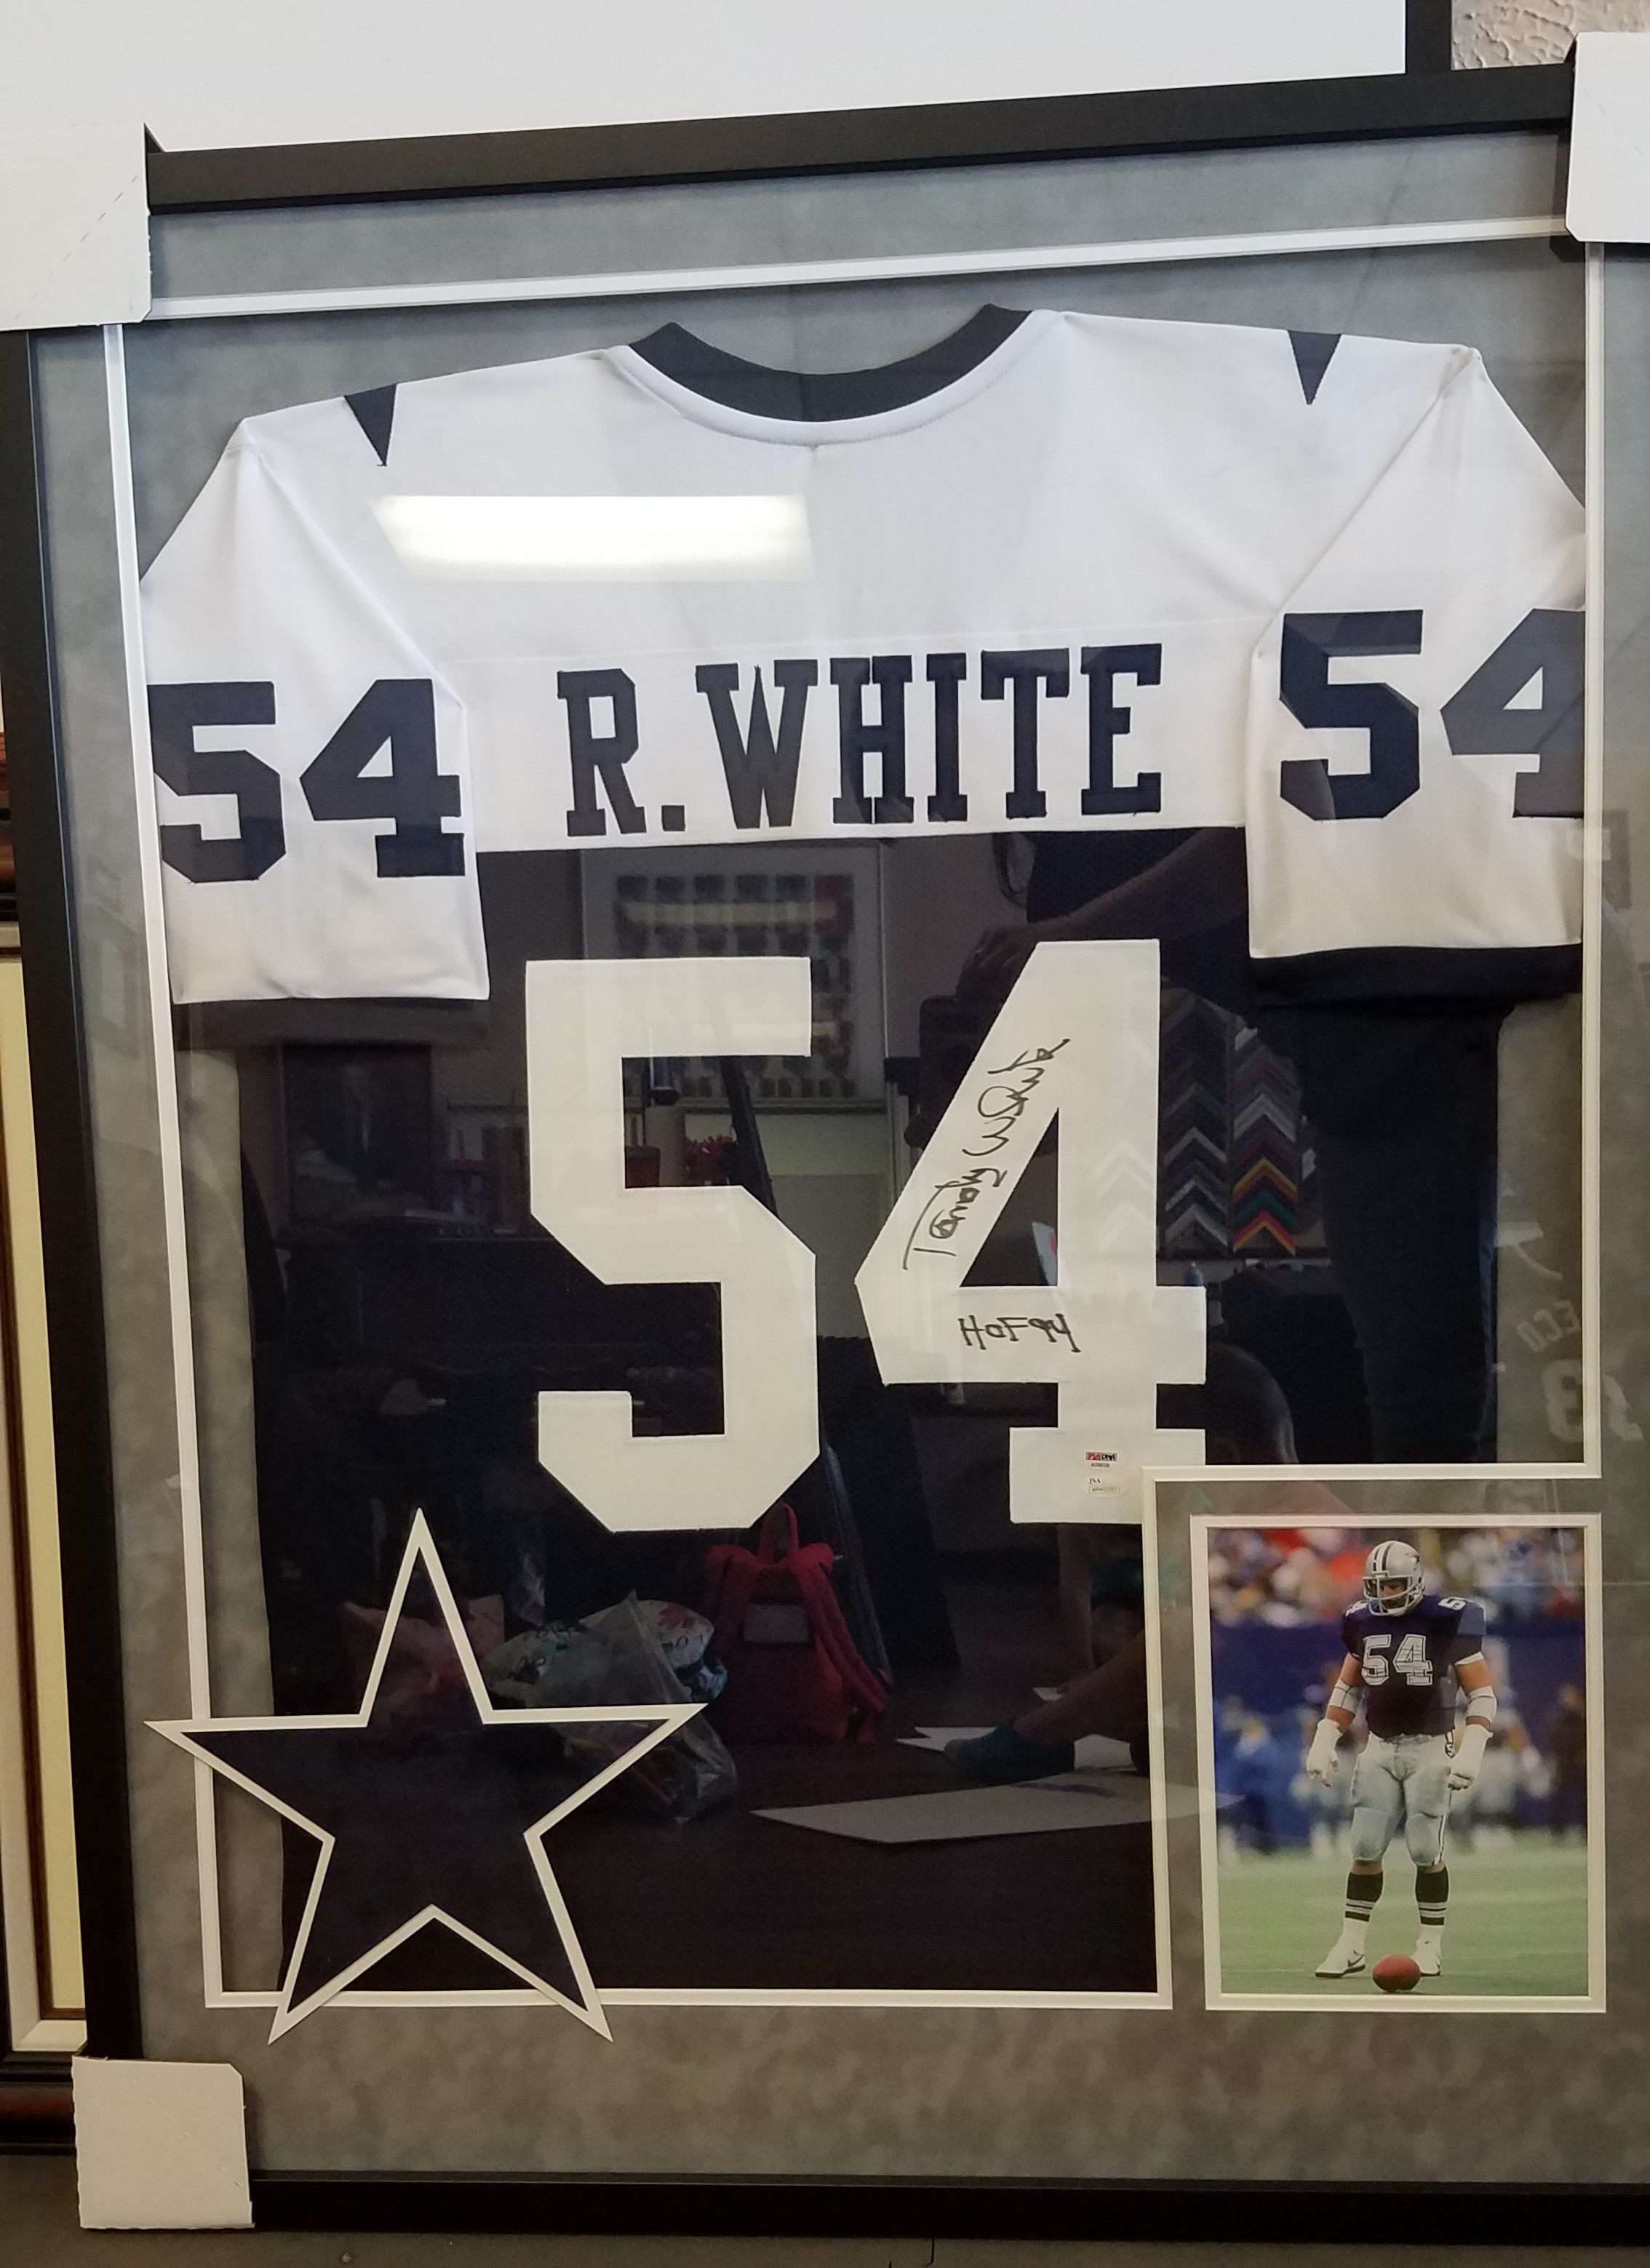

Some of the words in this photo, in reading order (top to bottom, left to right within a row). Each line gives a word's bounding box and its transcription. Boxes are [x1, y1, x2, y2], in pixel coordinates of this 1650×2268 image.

[147, 678, 466, 884] 54
[1279, 608, 1585, 821] 54
[525, 938, 1206, 1533] 54
[1361, 1634, 1433, 1685] 54
